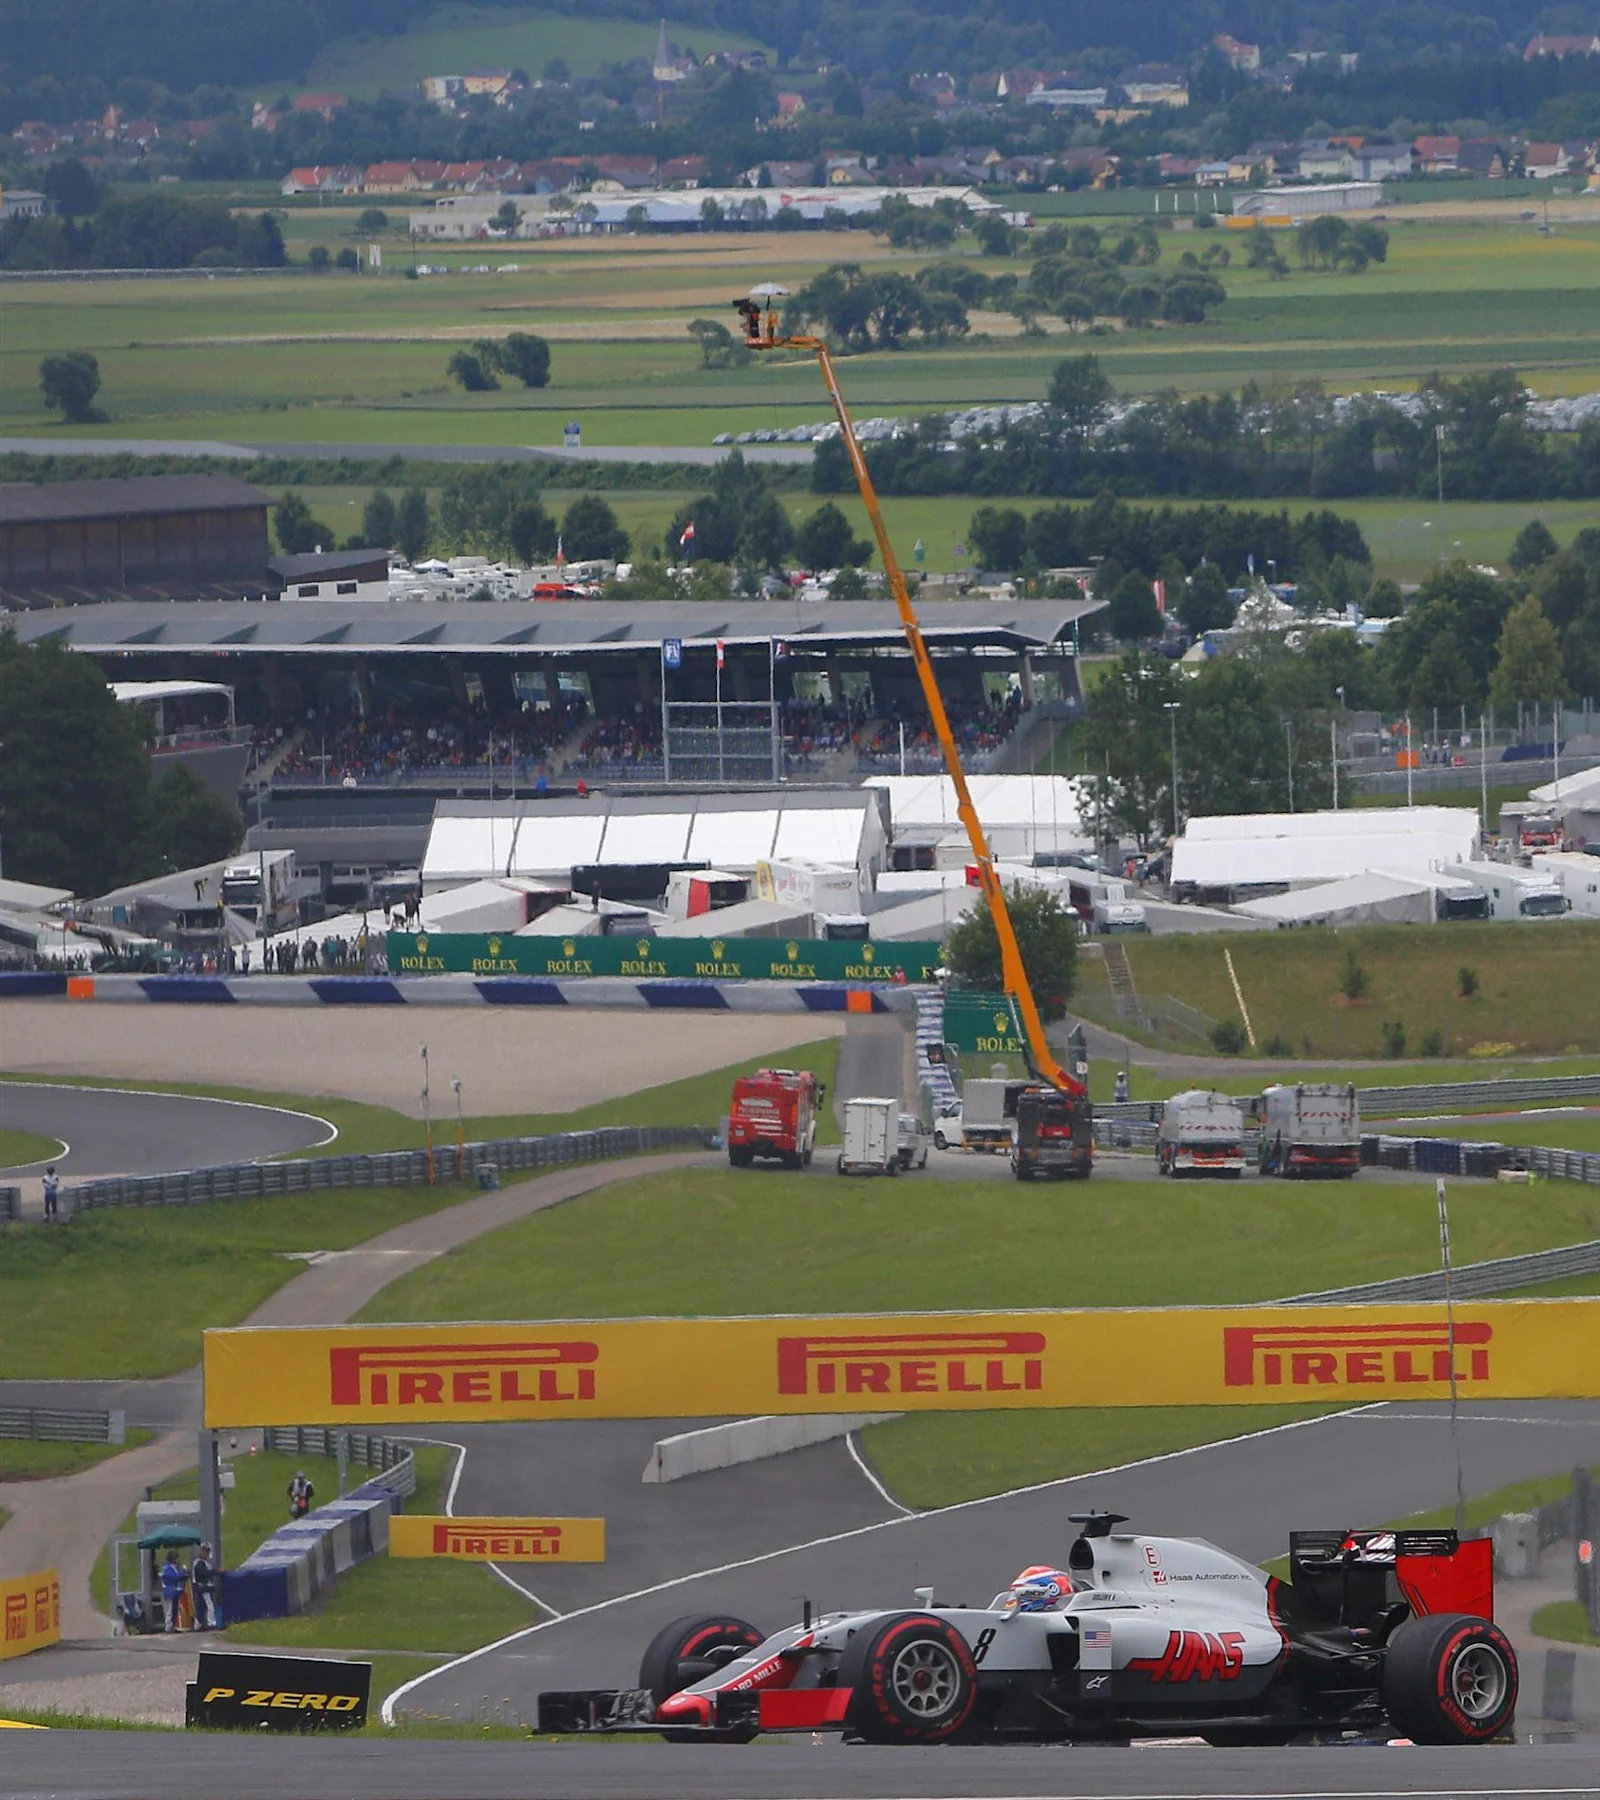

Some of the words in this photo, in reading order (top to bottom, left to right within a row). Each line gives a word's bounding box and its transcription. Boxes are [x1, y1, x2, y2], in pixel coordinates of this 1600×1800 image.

[401, 957, 444, 970] ROLEX
[473, 958, 517, 971] ROLEX
[547, 960, 593, 973] ROLEX
[621, 961, 666, 975] ROLEX
[696, 962, 741, 976] ROLEX
[770, 963, 816, 977] ROLEX
[845, 965, 891, 979] ROLEX
[331, 1342, 600, 1406] PIRELLI
[778, 1332, 1047, 1396] PIRELLI
[1224, 1321, 1493, 1387] PIRELLI
[433, 1524, 562, 1555] PIRELLI
[1195, 1573, 1239, 1581] Automation
[974, 1628, 997, 1664] 8
[1122, 1630, 1247, 1684] HAAS
[753, 1660, 782, 1683] MILLE
[203, 1687, 235, 1703] P
[241, 1690, 360, 1711] ZERO
